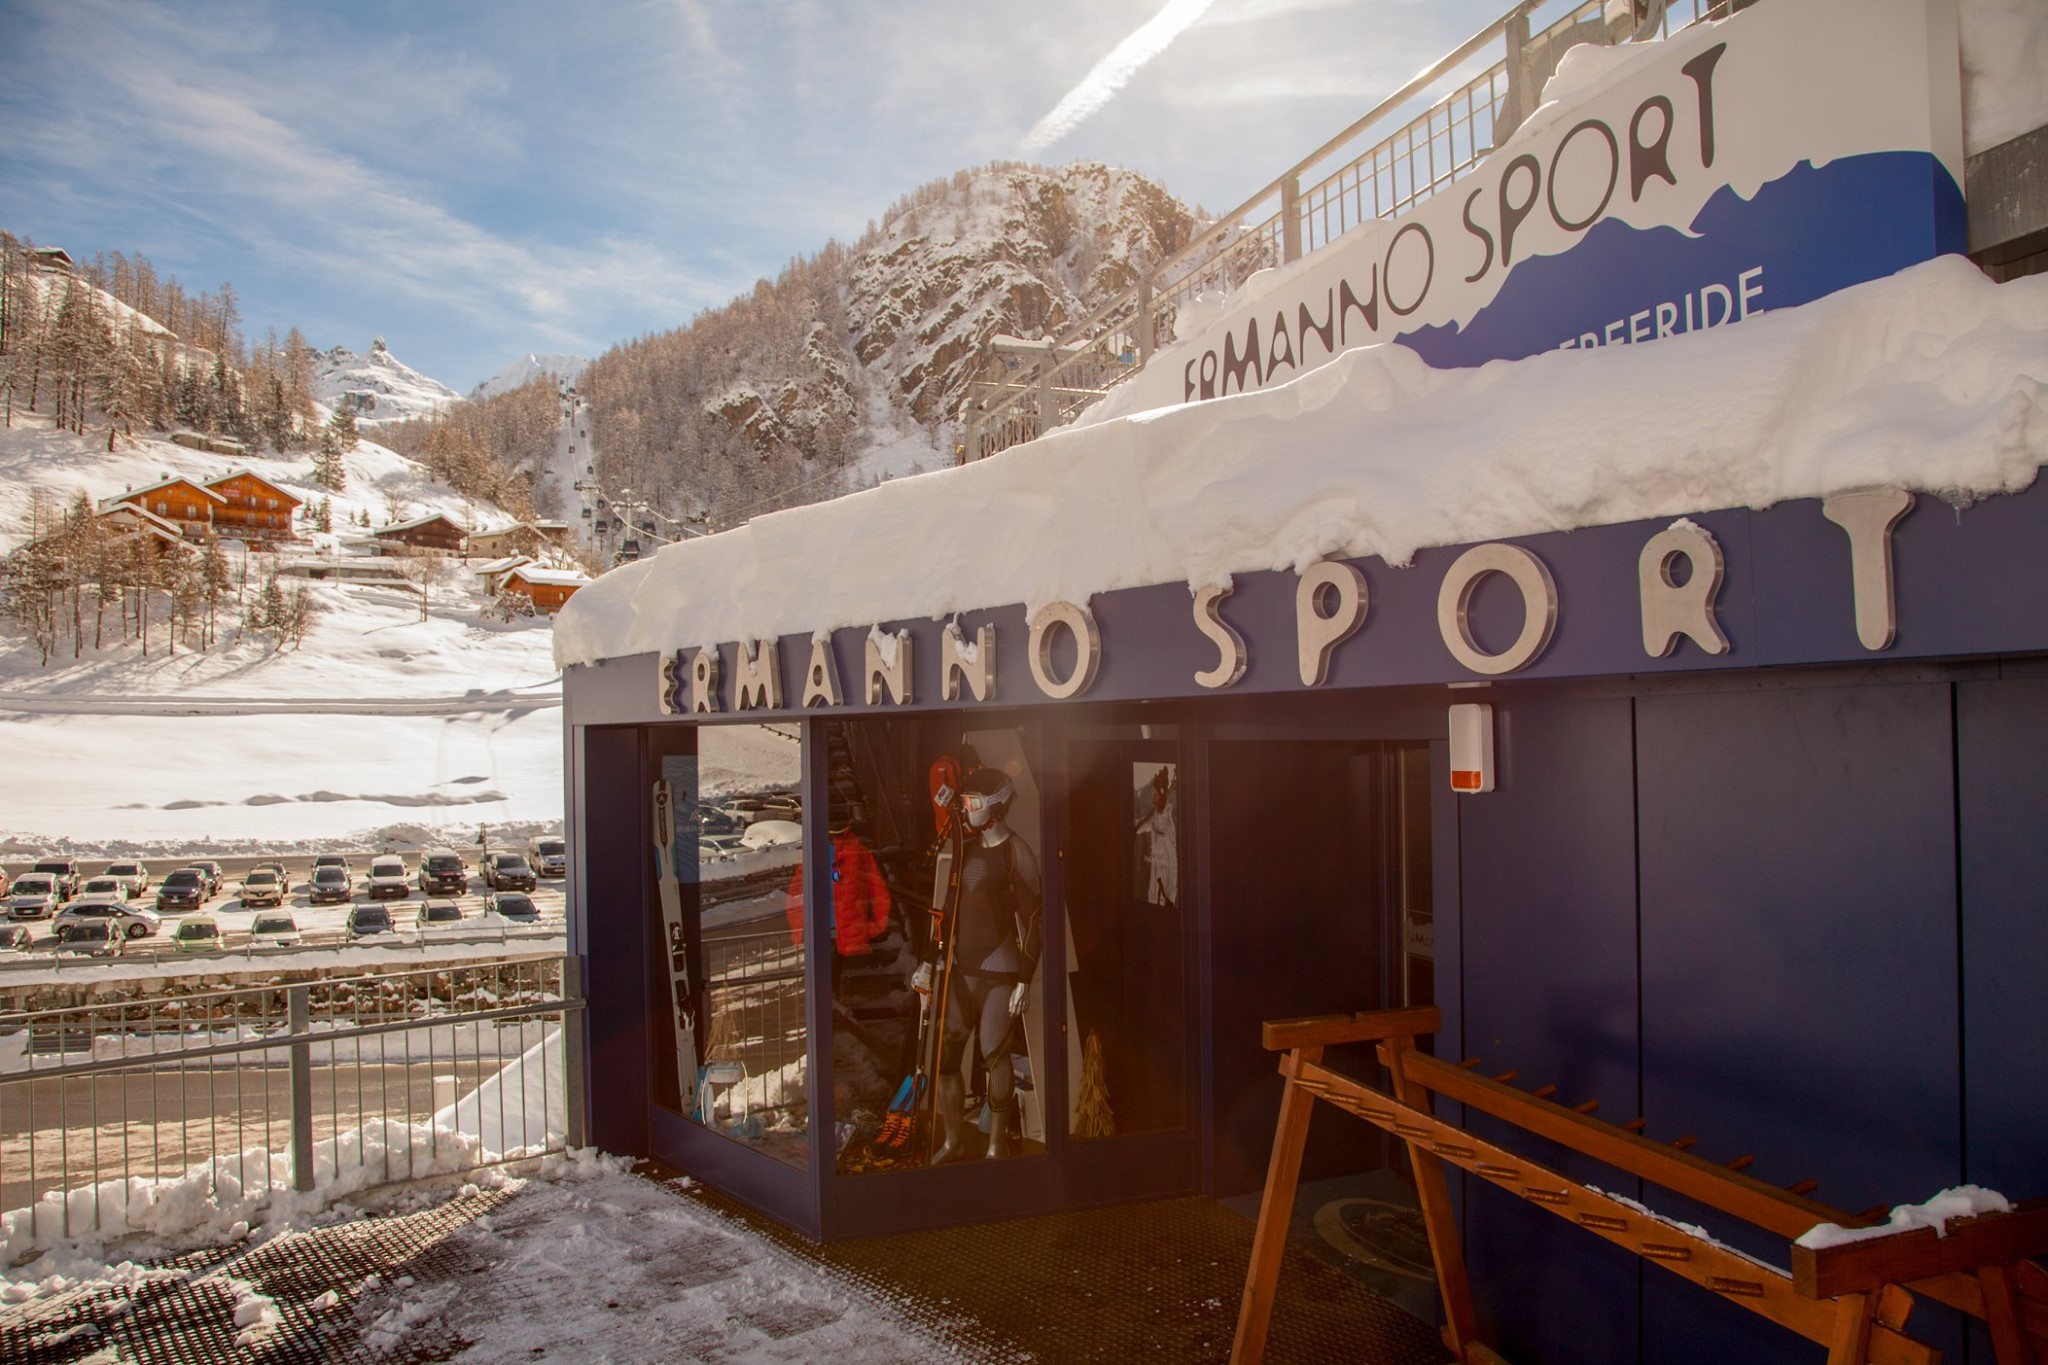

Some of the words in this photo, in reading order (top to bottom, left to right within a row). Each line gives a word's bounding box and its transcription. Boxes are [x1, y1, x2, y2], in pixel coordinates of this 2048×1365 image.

[1185, 222, 1434, 403] ERMANNO
[1464, 42, 1727, 283] SPORT
[658, 601, 1101, 715] ERMANNO
[1193, 489, 1917, 689] SPORT
